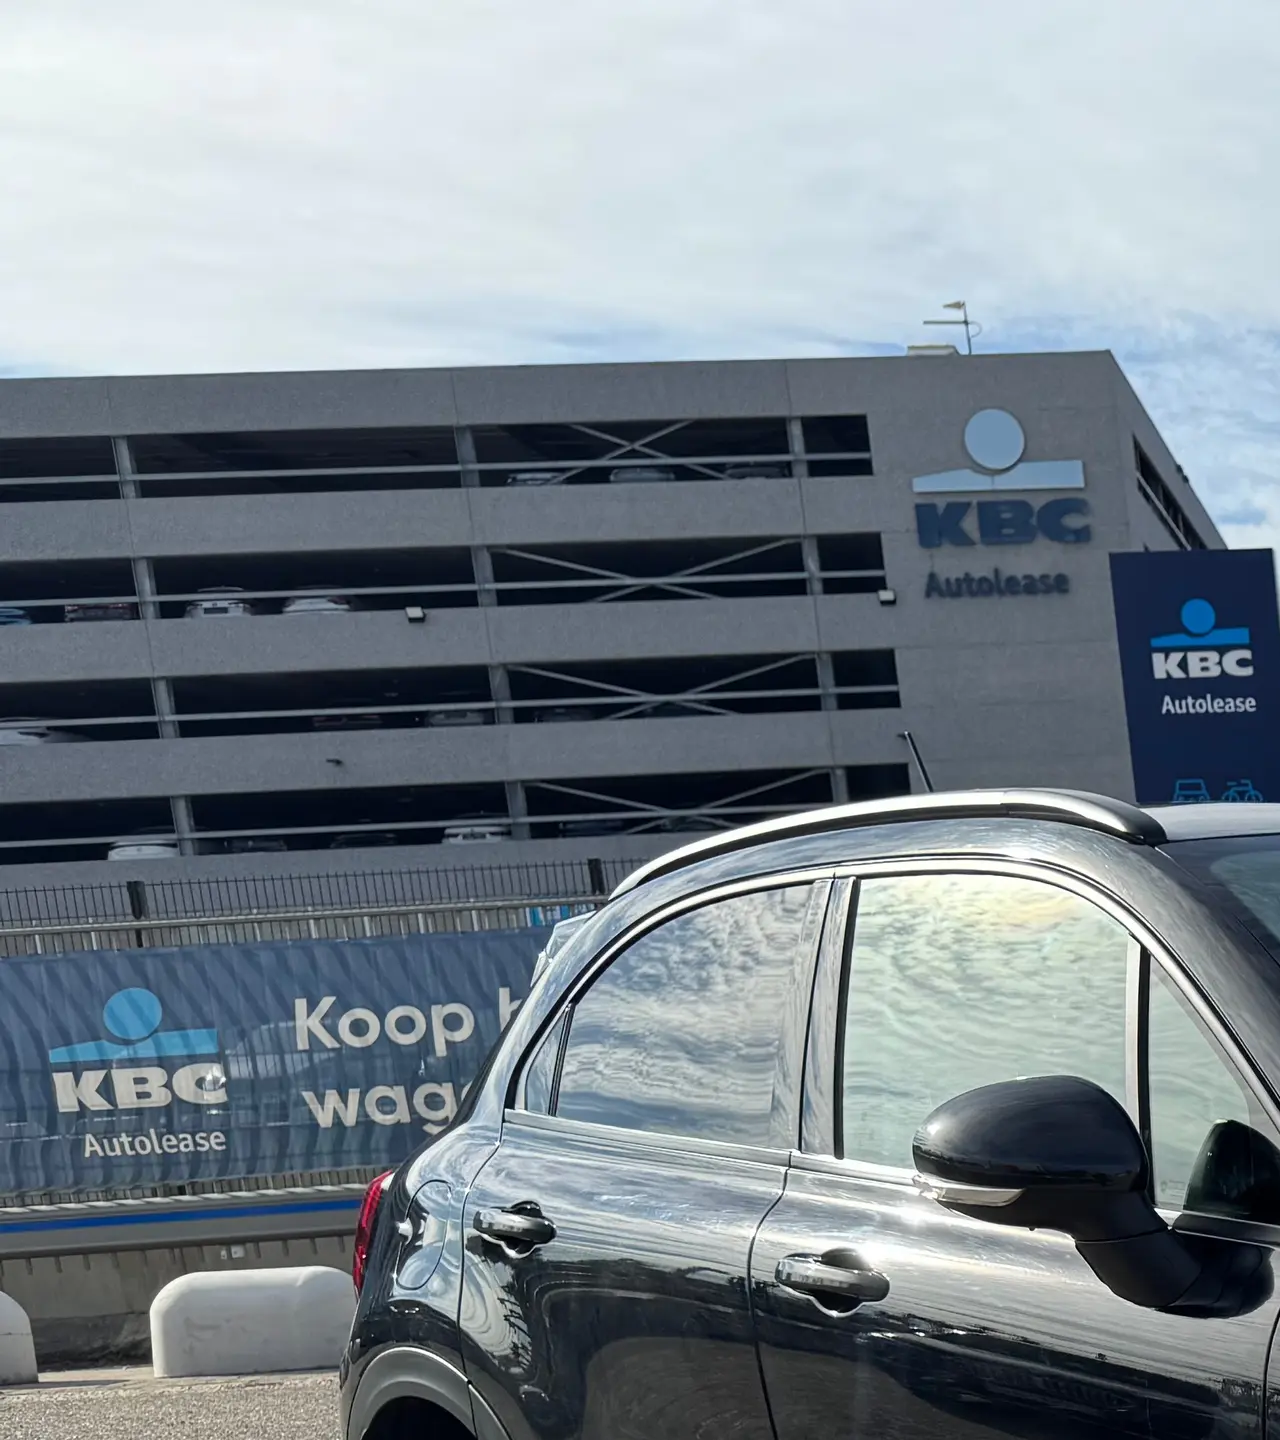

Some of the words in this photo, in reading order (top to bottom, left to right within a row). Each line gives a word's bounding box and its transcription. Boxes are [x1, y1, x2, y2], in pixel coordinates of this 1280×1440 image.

[914, 496, 1093, 549] KBC
[924, 566, 1070, 599] Autolease
[1151, 648, 1255, 680] KBC
[1161, 692, 1257, 716] Autolease
[294, 995, 475, 1058] Koop
[51, 1062, 228, 1113] KBC
[302, 1081, 473, 1136] wag
[84, 1127, 227, 1158] Autolease
